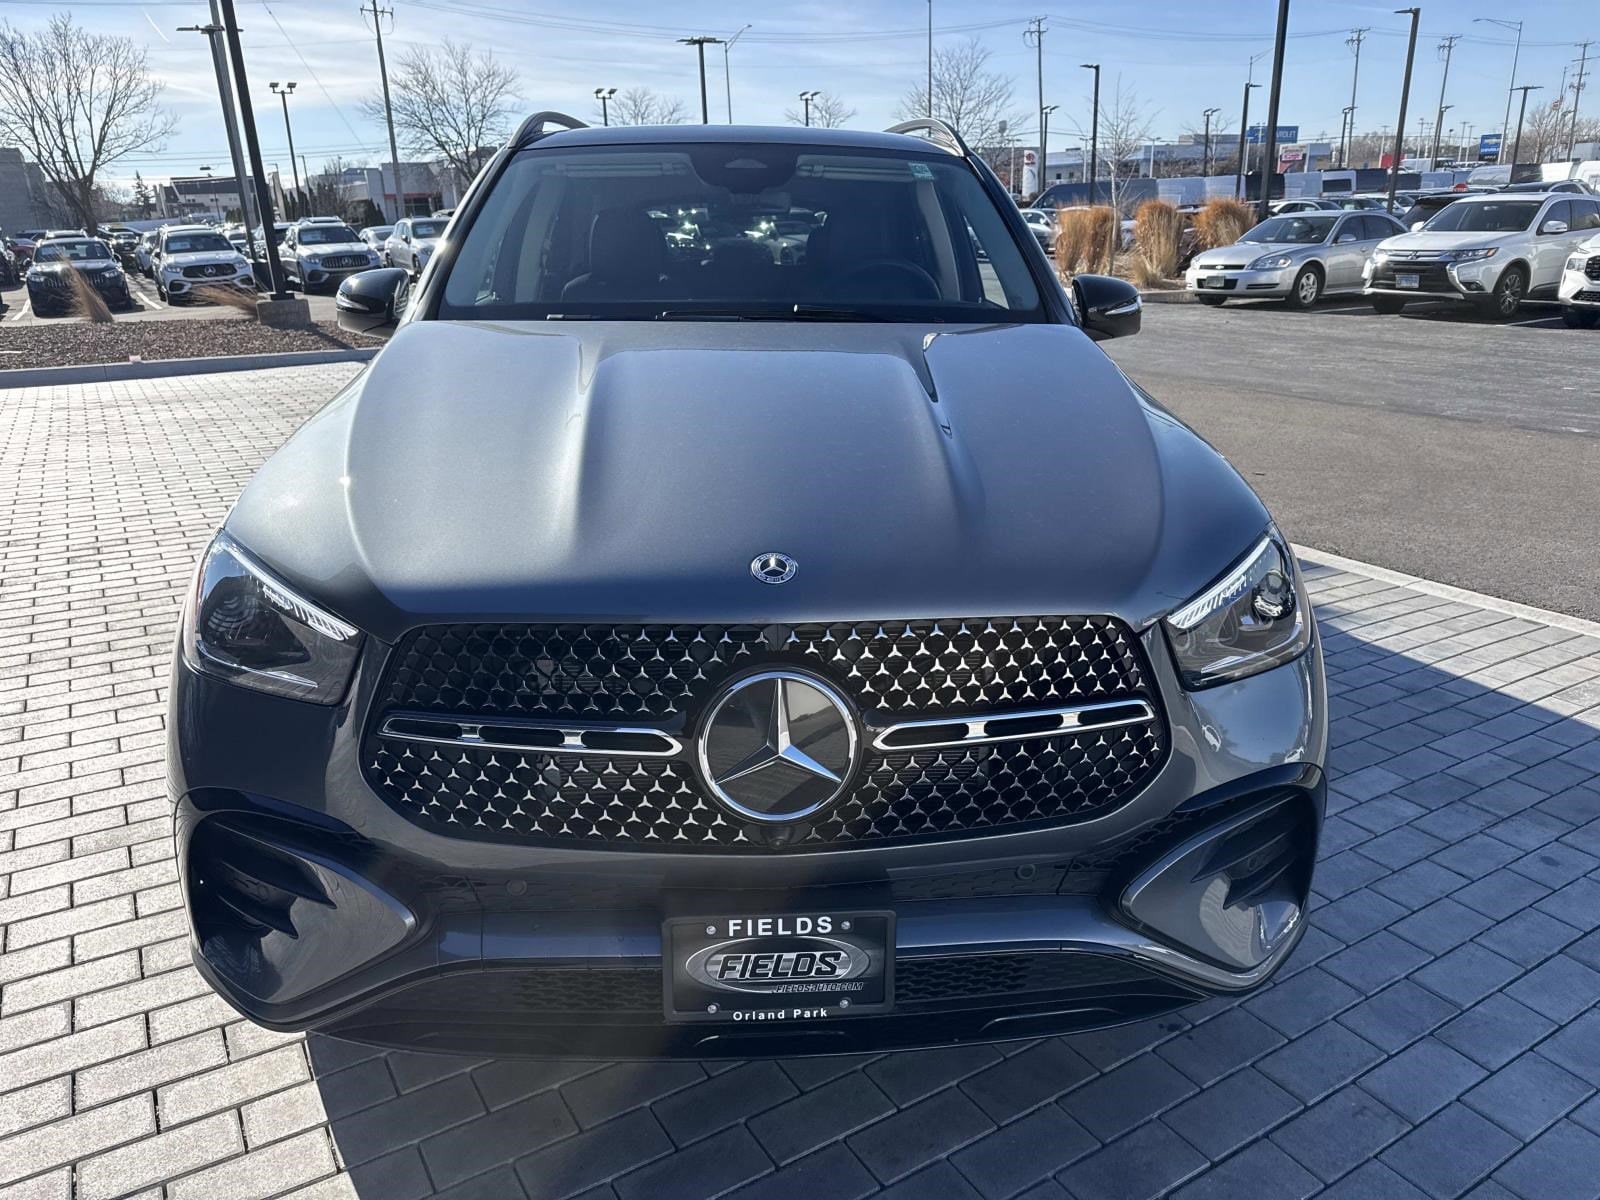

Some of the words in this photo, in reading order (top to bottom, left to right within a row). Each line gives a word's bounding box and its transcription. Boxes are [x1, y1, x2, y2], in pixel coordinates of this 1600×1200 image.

[728, 916, 833, 936] FIELDS
[717, 951, 842, 980] FIELDS
[733, 1010, 785, 1021] Orland
[793, 1008, 828, 1018] Park
